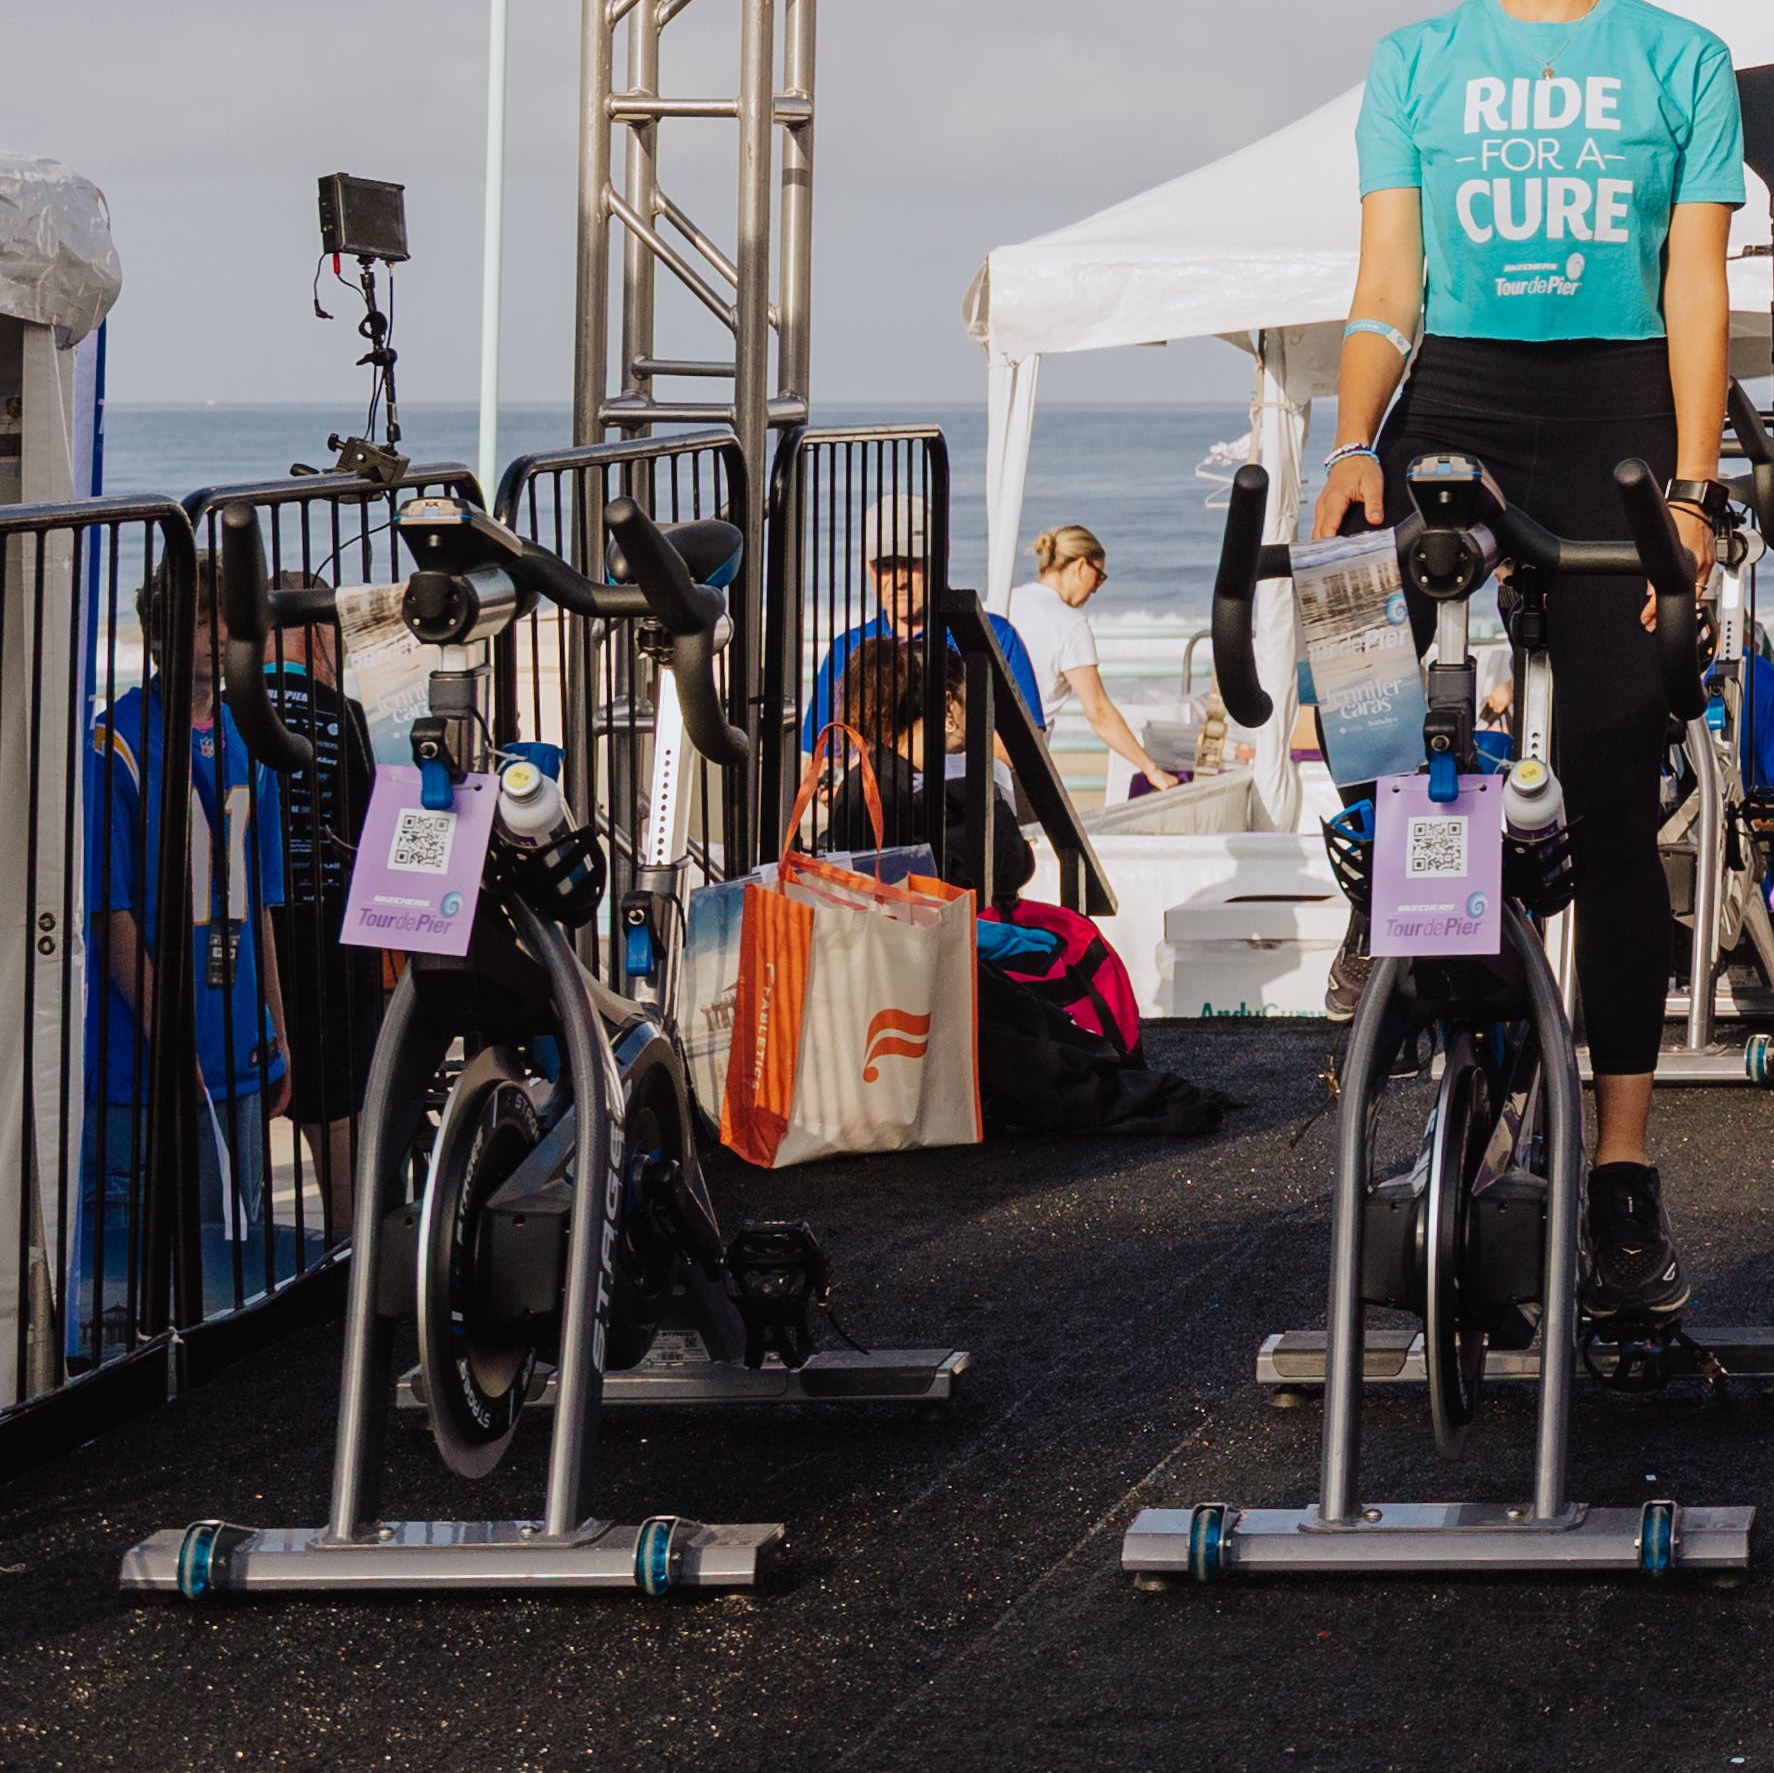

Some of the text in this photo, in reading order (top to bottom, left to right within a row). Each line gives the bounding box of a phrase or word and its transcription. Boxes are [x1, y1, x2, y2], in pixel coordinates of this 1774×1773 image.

[1464, 76, 1622, 134] RIDE
[1481, 137, 1606, 171] FOR A
[1455, 177, 1634, 243] CURE
